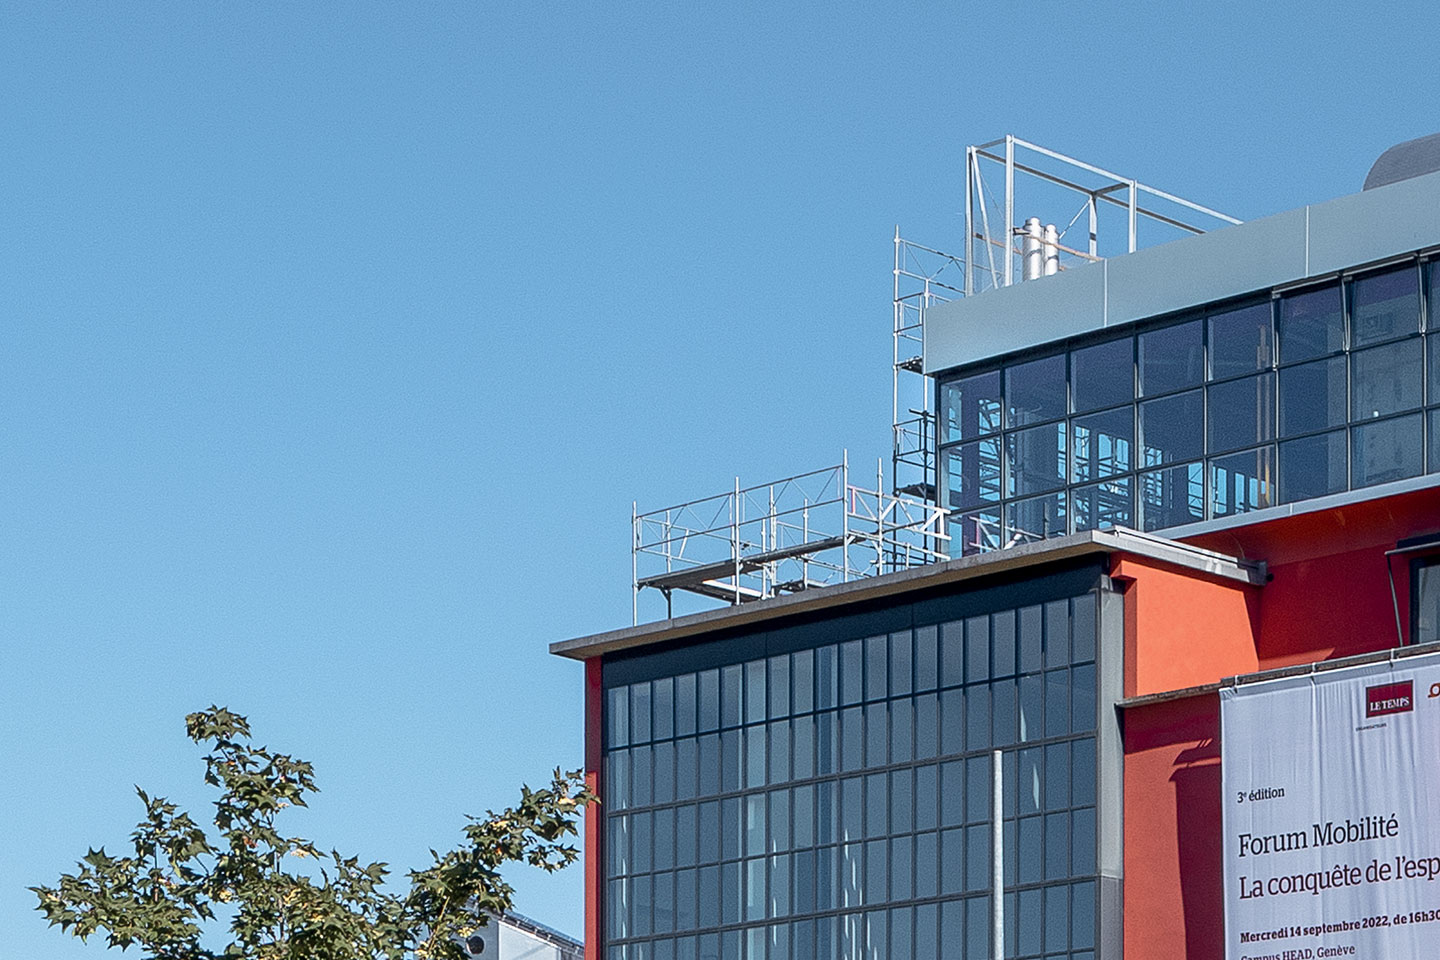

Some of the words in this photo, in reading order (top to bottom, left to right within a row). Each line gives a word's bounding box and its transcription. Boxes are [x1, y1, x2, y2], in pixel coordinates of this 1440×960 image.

[1370, 702, 1381, 712] LE
[1382, 696, 1410, 710] TEMPS
[1248, 787, 1285, 802] édition
[1238, 830, 1309, 858] Forum
[1312, 813, 1399, 848] Mobilité
[1239, 876, 1264, 900] La
[1267, 864, 1362, 896] conquête
[1365, 859, 1392, 883] de
[1240, 927, 1289, 944] Mercredi
[1290, 926, 1302, 938] 14
[1302, 921, 1361, 937] septembre
[1362, 915, 1392, 929] 2022,
[1393, 914, 1408, 926] de
[1316, 945, 1356, 958] Genève
